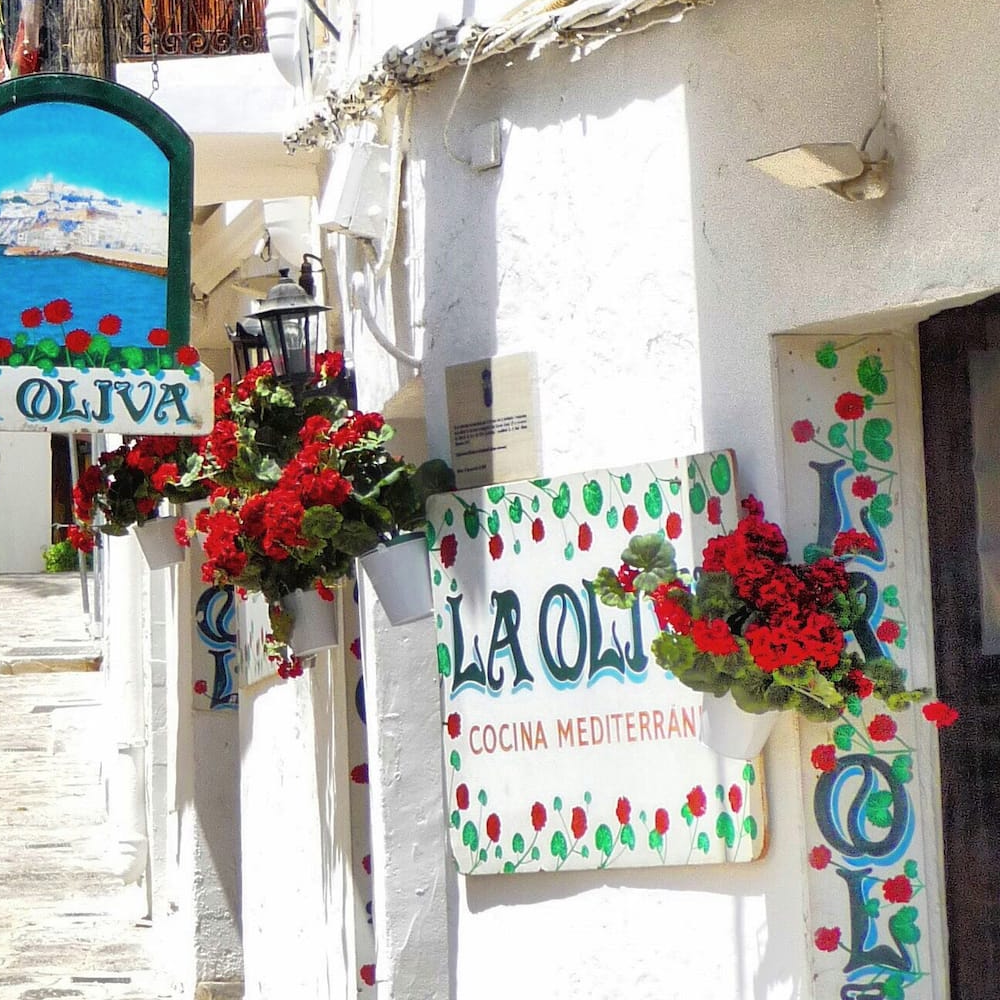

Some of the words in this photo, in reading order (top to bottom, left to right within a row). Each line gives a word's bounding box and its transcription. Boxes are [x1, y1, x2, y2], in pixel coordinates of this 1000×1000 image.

[16, 377, 199, 425] OLIVA
[445, 589, 535, 700] LA
[537, 578, 680, 692] OLI
[468, 720, 548, 755] COCINA
[556, 703, 703, 748] MEDITERRÁN
